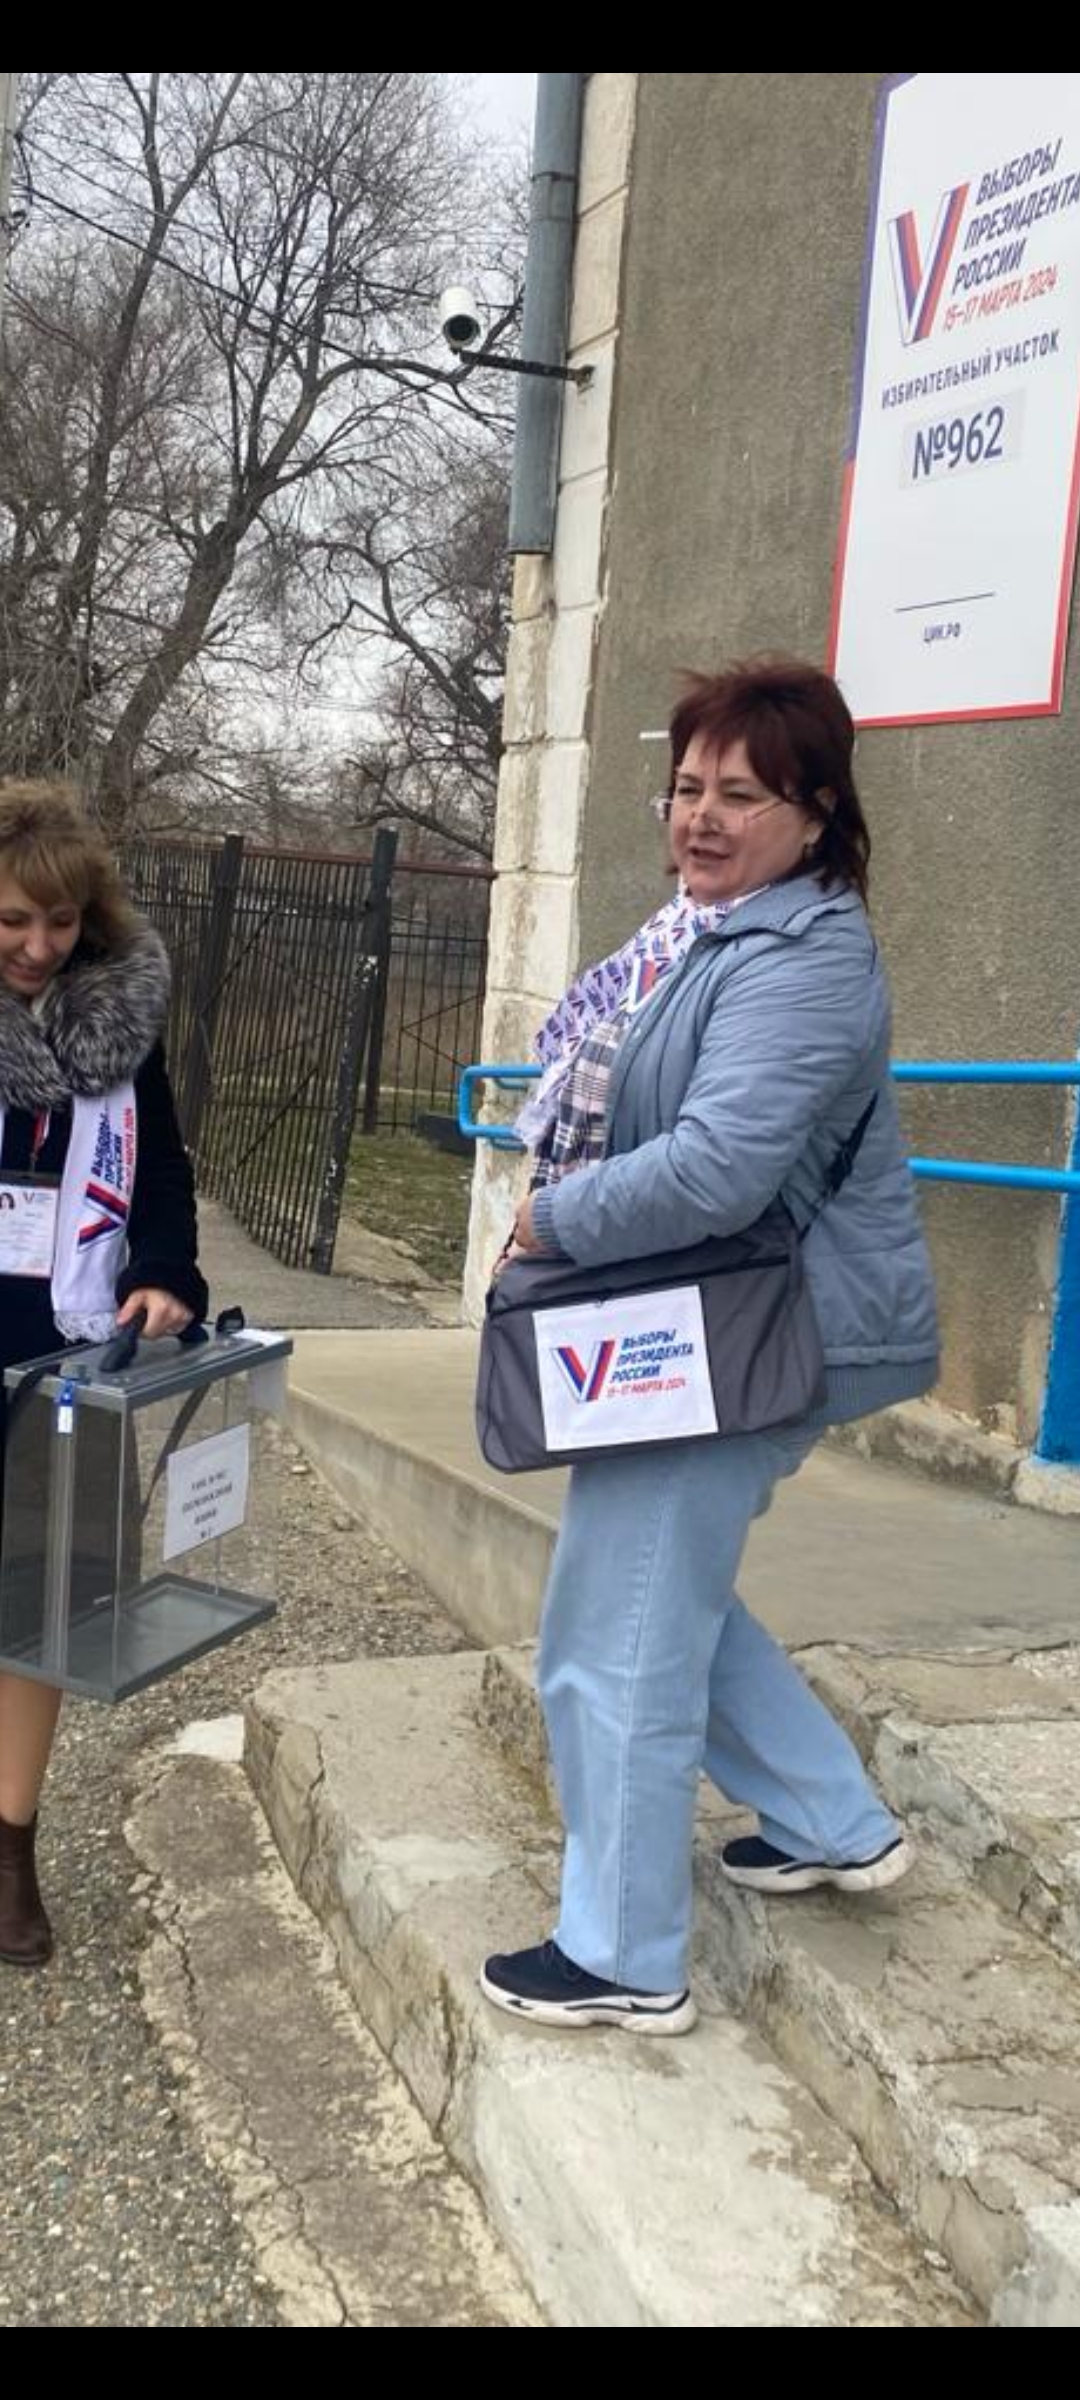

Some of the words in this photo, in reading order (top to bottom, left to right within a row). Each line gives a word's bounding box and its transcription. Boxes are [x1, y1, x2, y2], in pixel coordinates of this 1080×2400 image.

[975, 138, 1062, 206] ВЫБОРЫ
[964, 172, 1080, 251] ПРЕЗИДЕНТА
[952, 238, 1026, 295] РОССИИ
[978, 279, 1023, 317] МАРТА
[1023, 265, 1058, 301] 2024
[882, 348, 992, 409] ИЗБИРАТЕЛЬНЫЙ
[995, 329, 1060, 373] УЧАСТОК
[616, 1343, 694, 1367] ПРЕЗИДЕНТА
[621, 1328, 677, 1351] ВЫБОРЫ
[609, 1364, 662, 1383] РОССИИ
